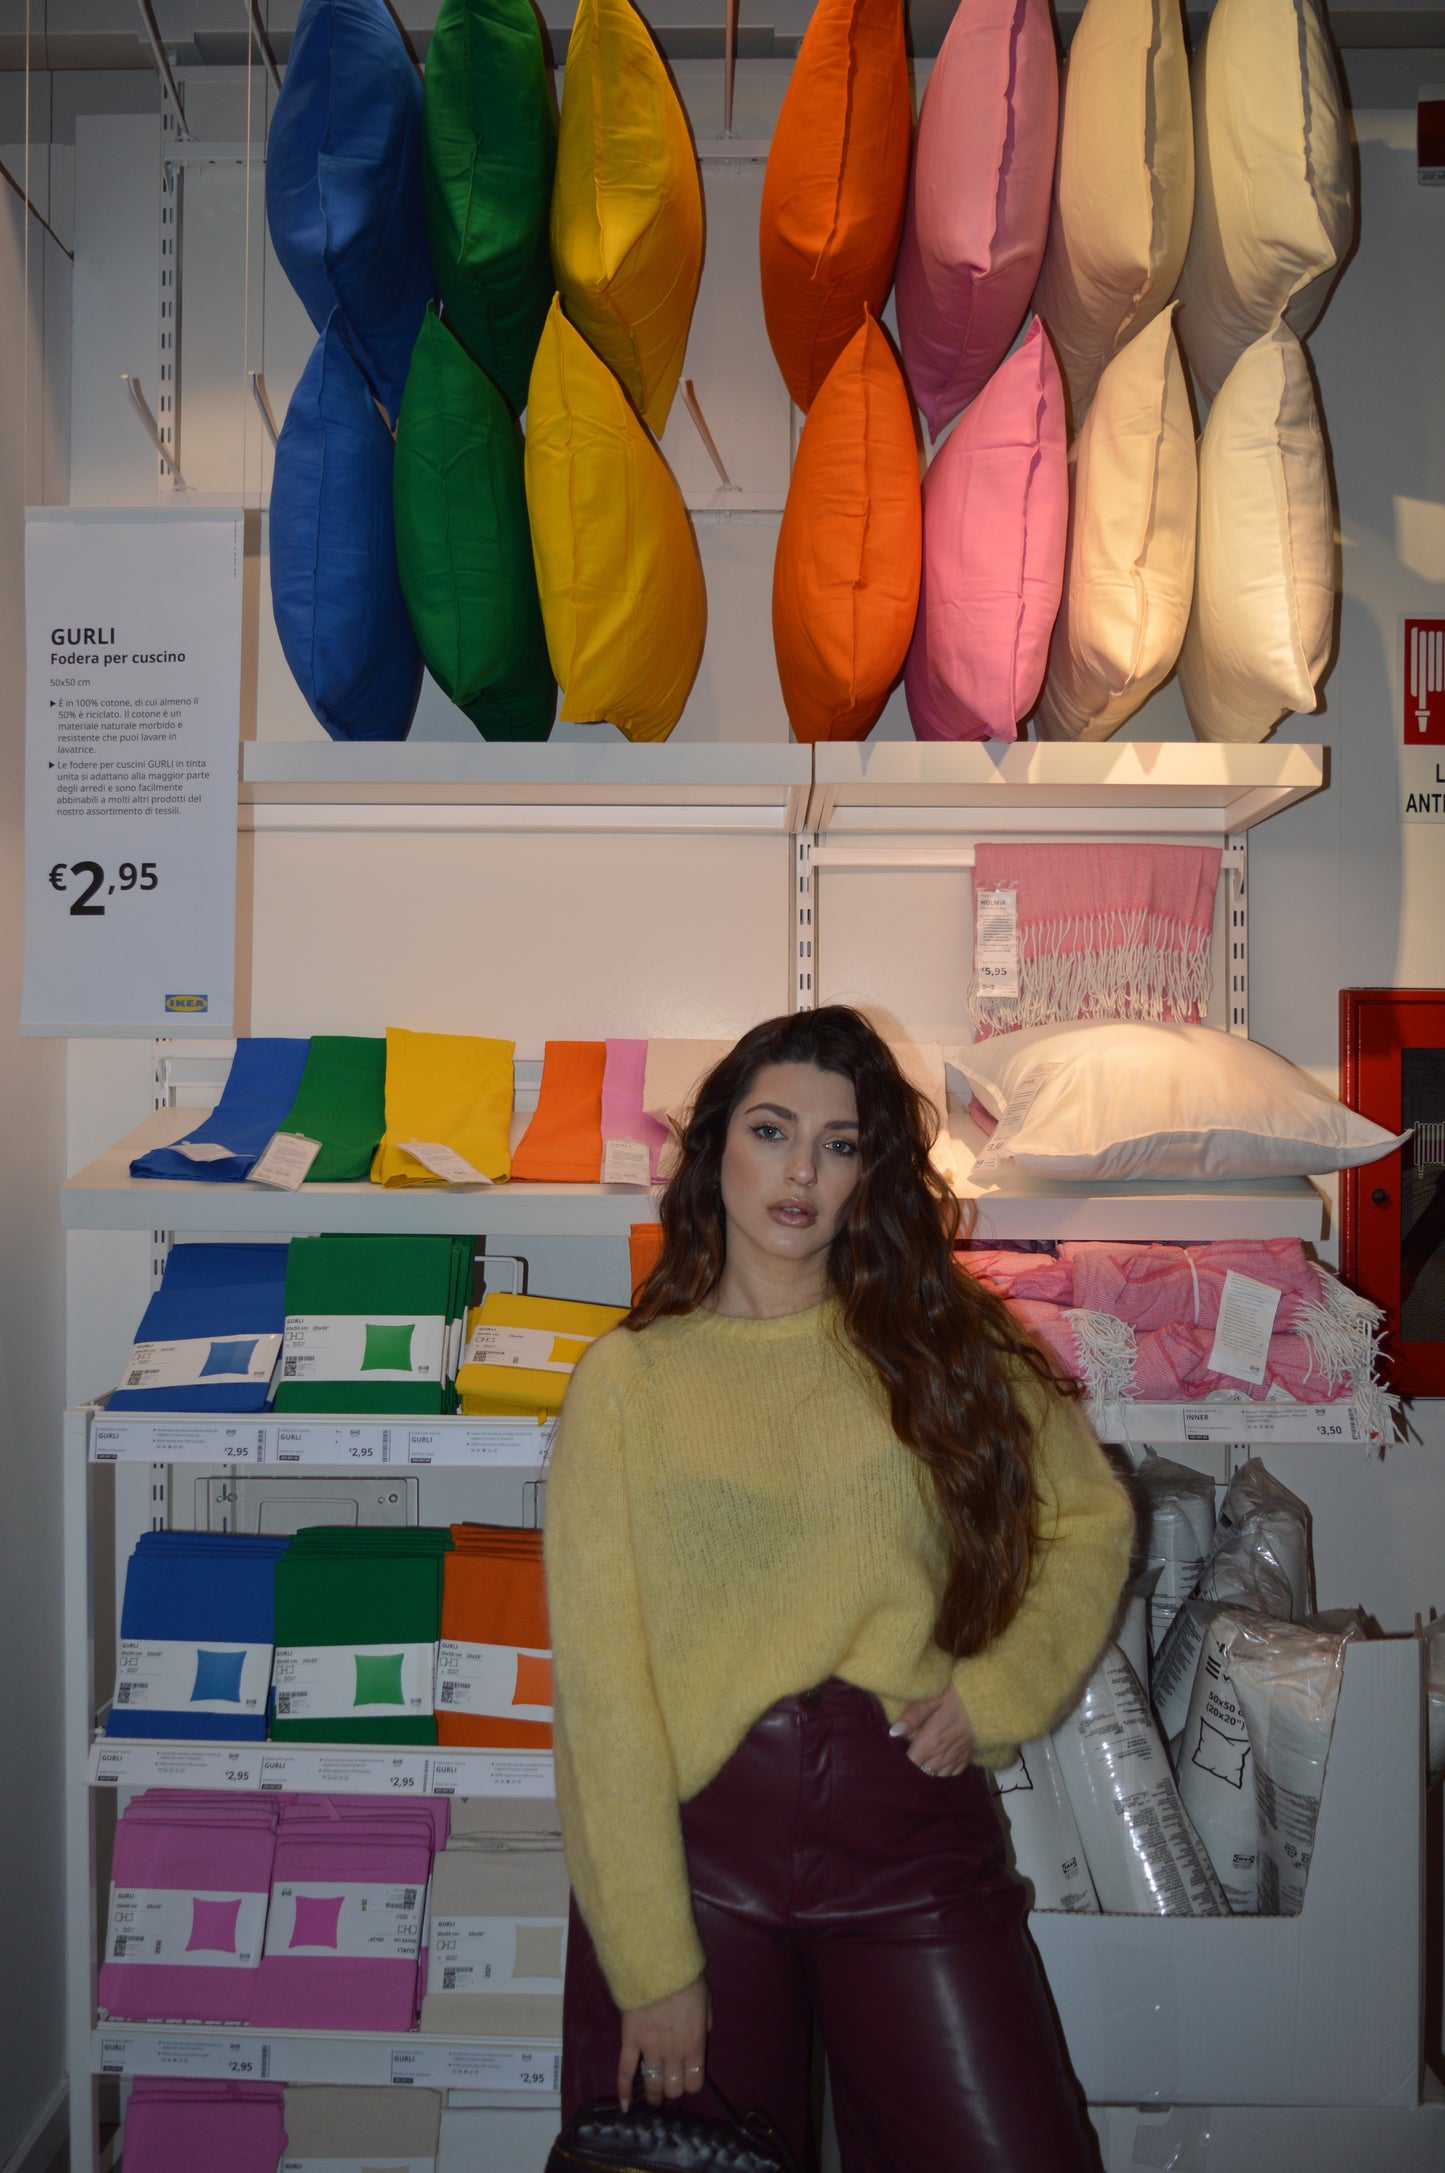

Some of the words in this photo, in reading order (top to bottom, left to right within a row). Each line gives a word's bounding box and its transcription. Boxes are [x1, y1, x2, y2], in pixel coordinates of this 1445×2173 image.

[51, 628, 115, 645] GURLI
[51, 652, 99, 665] Fodera
[104, 653, 127, 667] per
[132, 651, 185, 663] cuscino
[50, 679, 75, 687] 50x50
[59, 698, 64, 707] È
[66, 699, 73, 707] in
[76, 699, 97, 707] 100%
[101, 699, 132, 708] cotone,
[135, 698, 143, 706] di
[145, 698, 157, 706] cui
[160, 697, 191, 706] almeno
[193, 697, 199, 705] il
[59, 711, 76, 719] 50%
[79, 710, 84, 718] è
[86, 710, 121, 719] riciclato.
[124, 710, 129, 718] Il
[163, 709, 168, 717] è
[58, 722, 99, 730] materiale
[101, 722, 136, 730] naturale
[139, 721, 175, 729] morbido
[58, 734, 100, 742] resistente
[102, 734, 118, 742] che
[120, 734, 139, 743] puoi
[141, 733, 166, 741] lavare
[58, 745, 96, 754] lavatrice.
[58, 761, 67, 769] Le
[70, 761, 97, 769] fodere
[100, 762, 115, 771] per
[116, 760, 145, 769] cuscini
[148, 760, 173, 768] GURLI
[176, 760, 183, 768] in
[186, 760, 206, 768] tinta
[57, 773, 79, 781] unita
[81, 773, 88, 781] si
[90, 772, 129, 781] adattano
[131, 772, 146, 780] alla
[148, 772, 184, 782] maggior
[187, 773, 210, 781] parte
[57, 785, 77, 794] degli
[80, 784, 105, 792] arredi
[139, 783, 183, 792] facilmente
[57, 796, 98, 804] abbinabili
[108, 796, 130, 804] molti
[132, 795, 149, 803] altri
[151, 795, 185, 804] prodotti
[188, 795, 202, 803] del
[57, 808, 84, 816] nostro
[86, 807, 142, 815] assortimento
[145, 807, 153, 815] di
[49, 861, 159, 916] €2,95
[981, 967, 1007, 976] €5,95
[169, 999, 204, 1007] IKEA
[1317, 1426, 1342, 1435] €3,50
[280, 1433, 302, 1441] GURLI
[224, 1447, 249, 1457] €2,95
[349, 1447, 373, 1457] €2,95
[1208, 1691, 1235, 1713] 50x50
[1206, 1703, 1245, 1730] (20x20")
[225, 1771, 249, 1781] €2,95
[390, 1777, 415, 1787] €2,95
[229, 2062, 253, 2072] €2,95
[521, 2073, 544, 2083] €2,95
